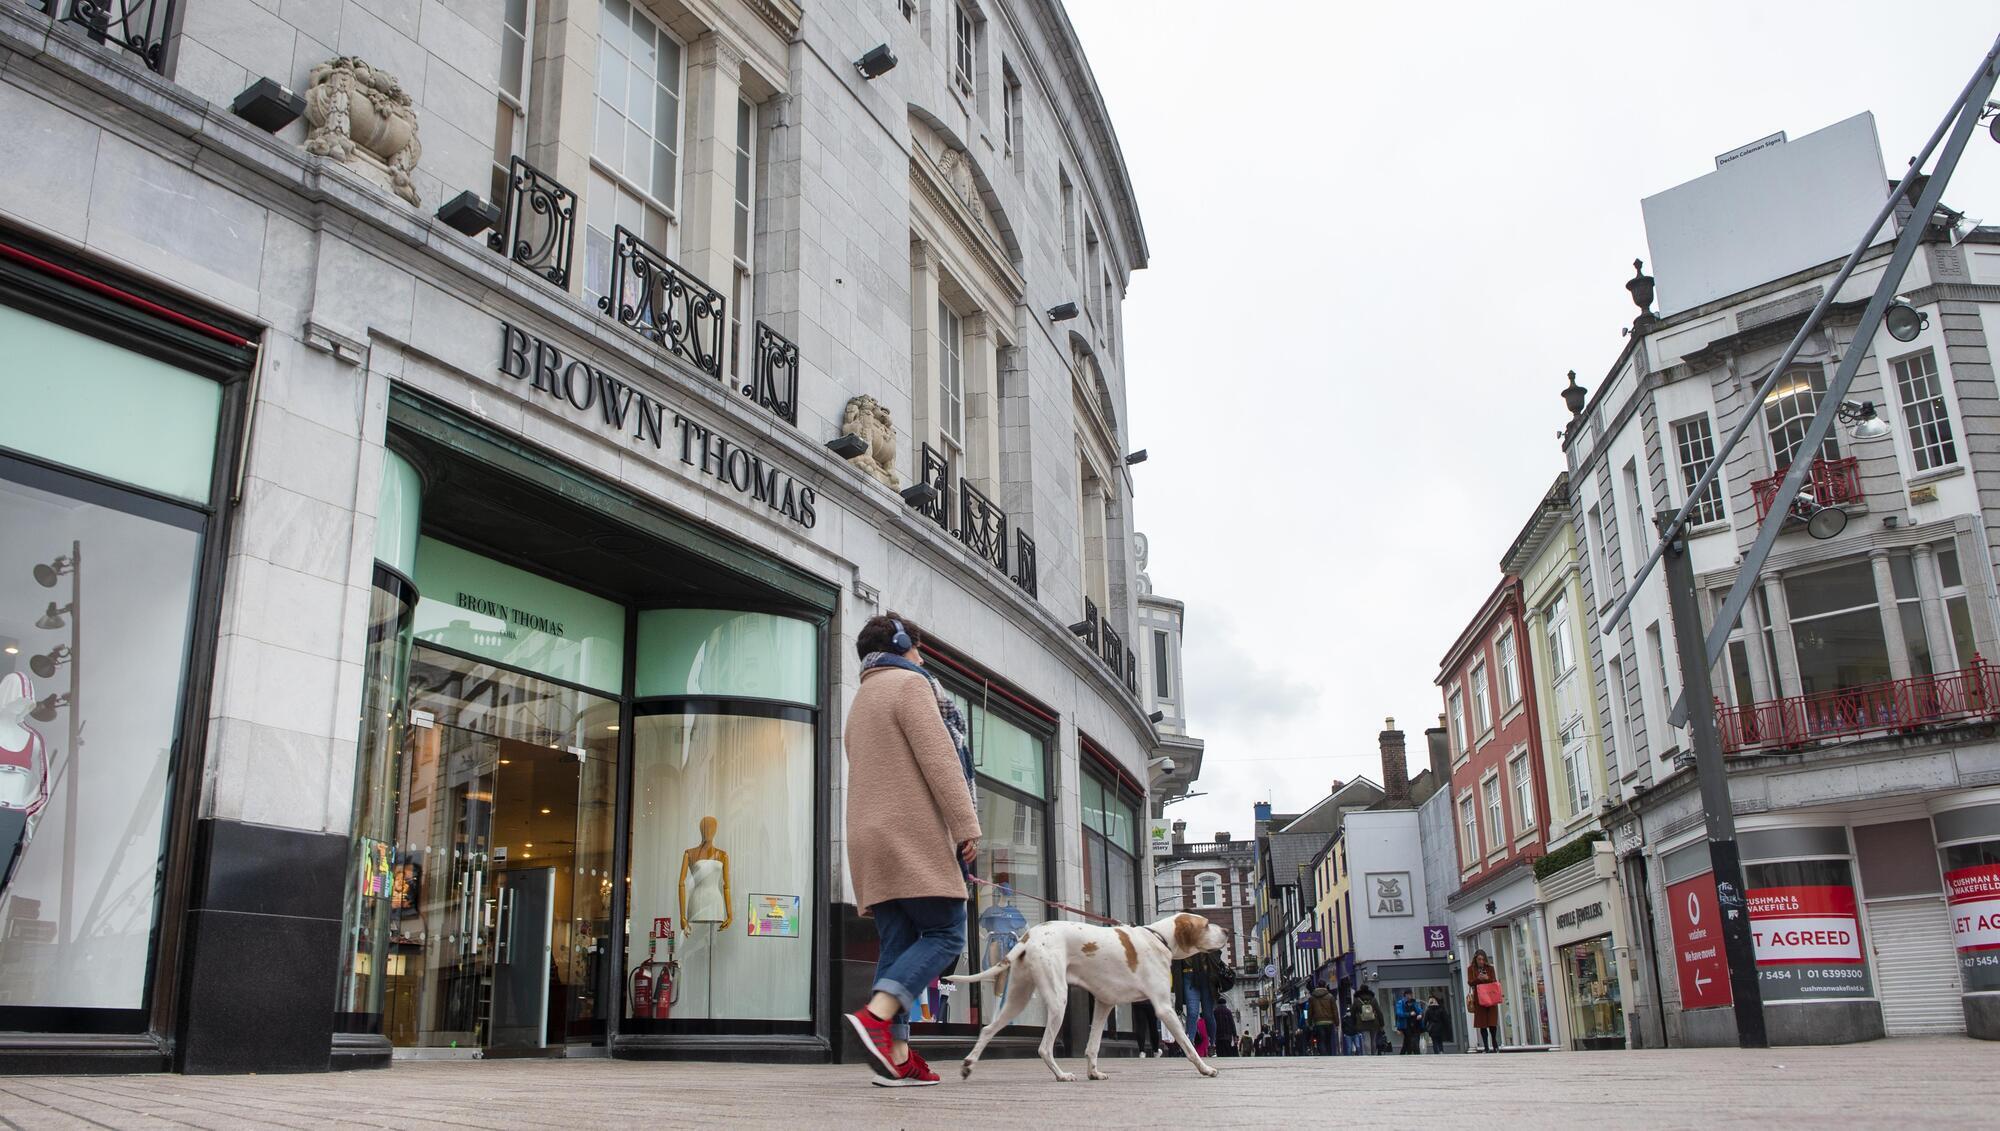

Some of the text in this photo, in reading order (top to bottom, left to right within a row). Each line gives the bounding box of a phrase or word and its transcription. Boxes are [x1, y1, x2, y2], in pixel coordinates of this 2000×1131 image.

[1720, 138, 1781, 165] Declan Coleman Signs
[498, 321, 817, 529] BROWN THOMAS
[457, 592, 564, 637] BROWN THOMAS
[1620, 822, 1633, 838] LEE
[1953, 875, 1990, 887] CUSHMAN
[1954, 882, 2000, 895] WAKEFIELD
[1378, 899, 1404, 913] AIB
[1791, 895, 1798, 903] &
[1556, 901, 1603, 929] NEVILLE JEWELLERS
[1771, 931, 1850, 947] AGREED
[1976, 955, 1998, 966] 5454
[1766, 970, 1792, 980] 5454
[1807, 970, 1820, 978] 01
[1822, 969, 1863, 978] 6399300
